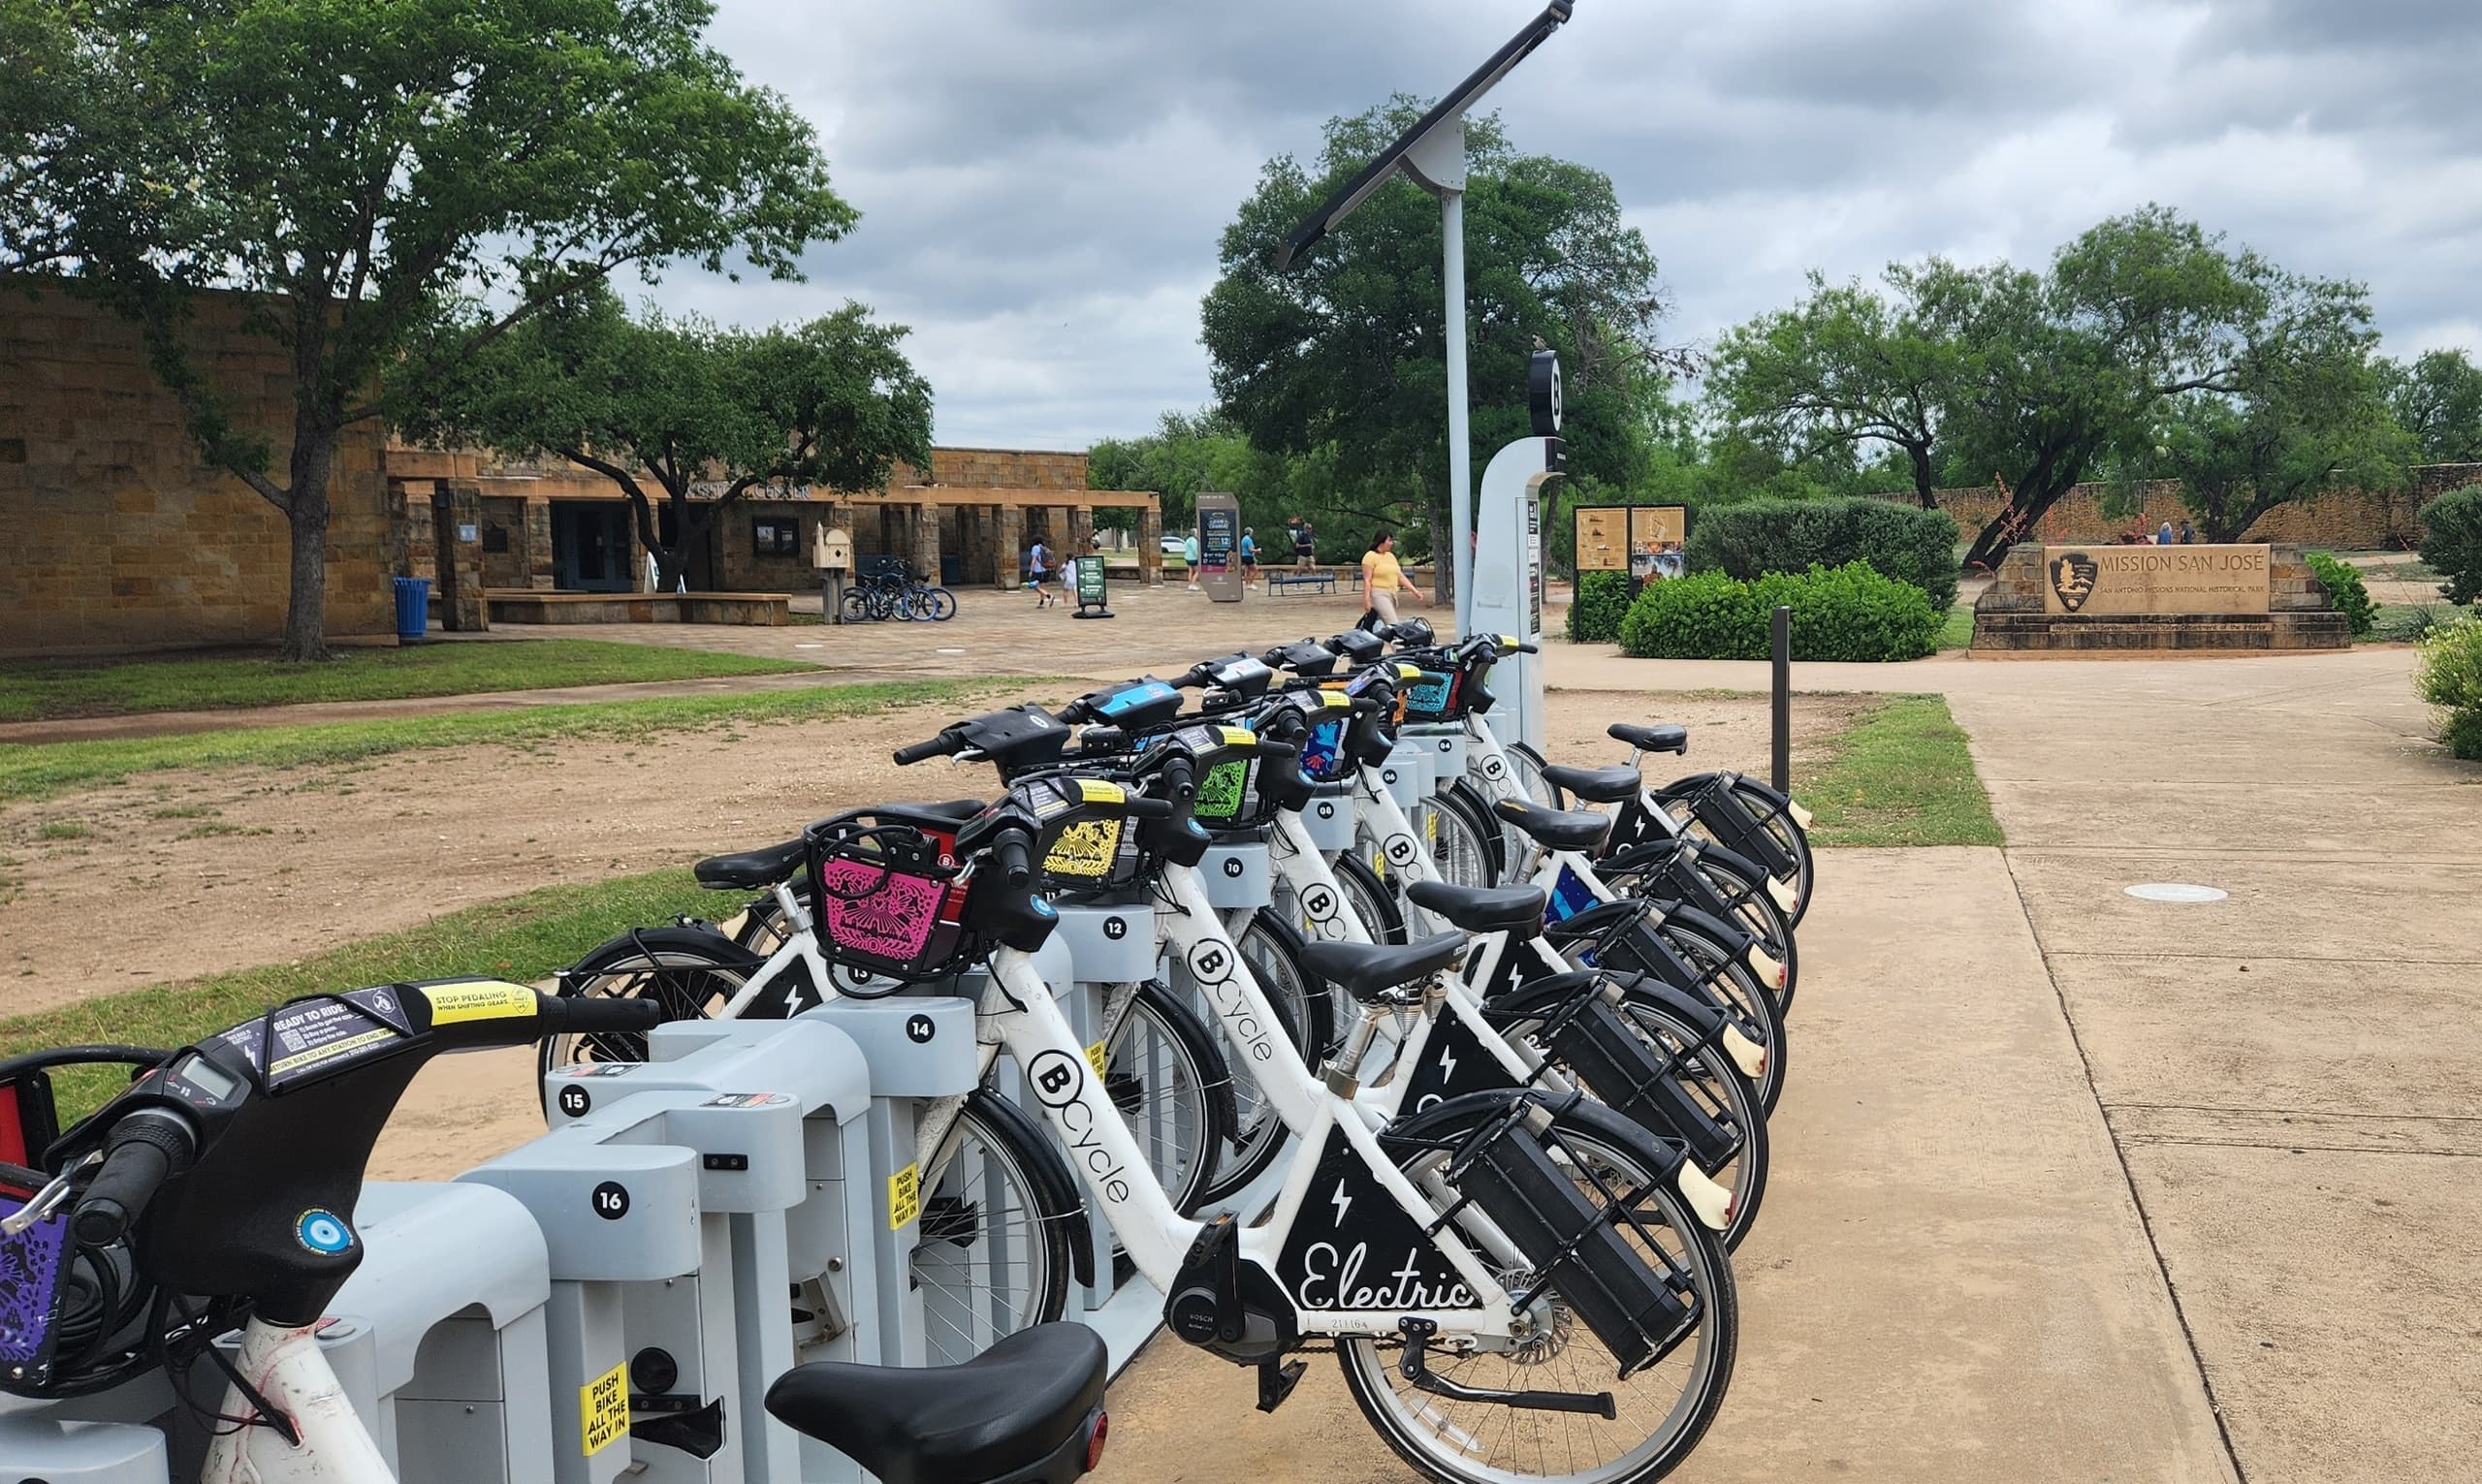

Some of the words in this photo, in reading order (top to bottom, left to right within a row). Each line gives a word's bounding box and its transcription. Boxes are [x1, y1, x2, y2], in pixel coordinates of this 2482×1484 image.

[2101, 556, 2171, 571] MISSION
[2179, 555, 2212, 571] SAN
[2219, 550, 2264, 571] JOSÉ
[1227, 863, 1239, 873] 10
[1107, 923, 1122, 934] 12
[436, 995, 459, 1004] STOP
[461, 991, 507, 1002] PEDALING
[273, 1014, 305, 1031] READY
[304, 1010, 320, 1022] TO
[912, 1022, 929, 1036] 14
[319, 1048, 331, 1057] ANY
[332, 1040, 357, 1051] STATION
[565, 1093, 584, 1109] 15
[897, 1168, 913, 1187] PUSH
[899, 1182, 911, 1198] BIKE
[600, 1191, 621, 1210] 16
[894, 1198, 906, 1214] ALL
[906, 1190, 916, 1204] THE
[895, 1207, 909, 1225] WAY
[909, 1202, 916, 1215] IN
[1300, 1242, 1475, 1309] Electric
[1189, 1313, 1213, 1323] BOSCH
[592, 1373, 620, 1400] PUSH
[595, 1389, 618, 1414] BIKE
[588, 1414, 606, 1436] ALL
[608, 1400, 625, 1421] THE
[589, 1425, 613, 1449] WAY
[615, 1416, 625, 1433] IN
